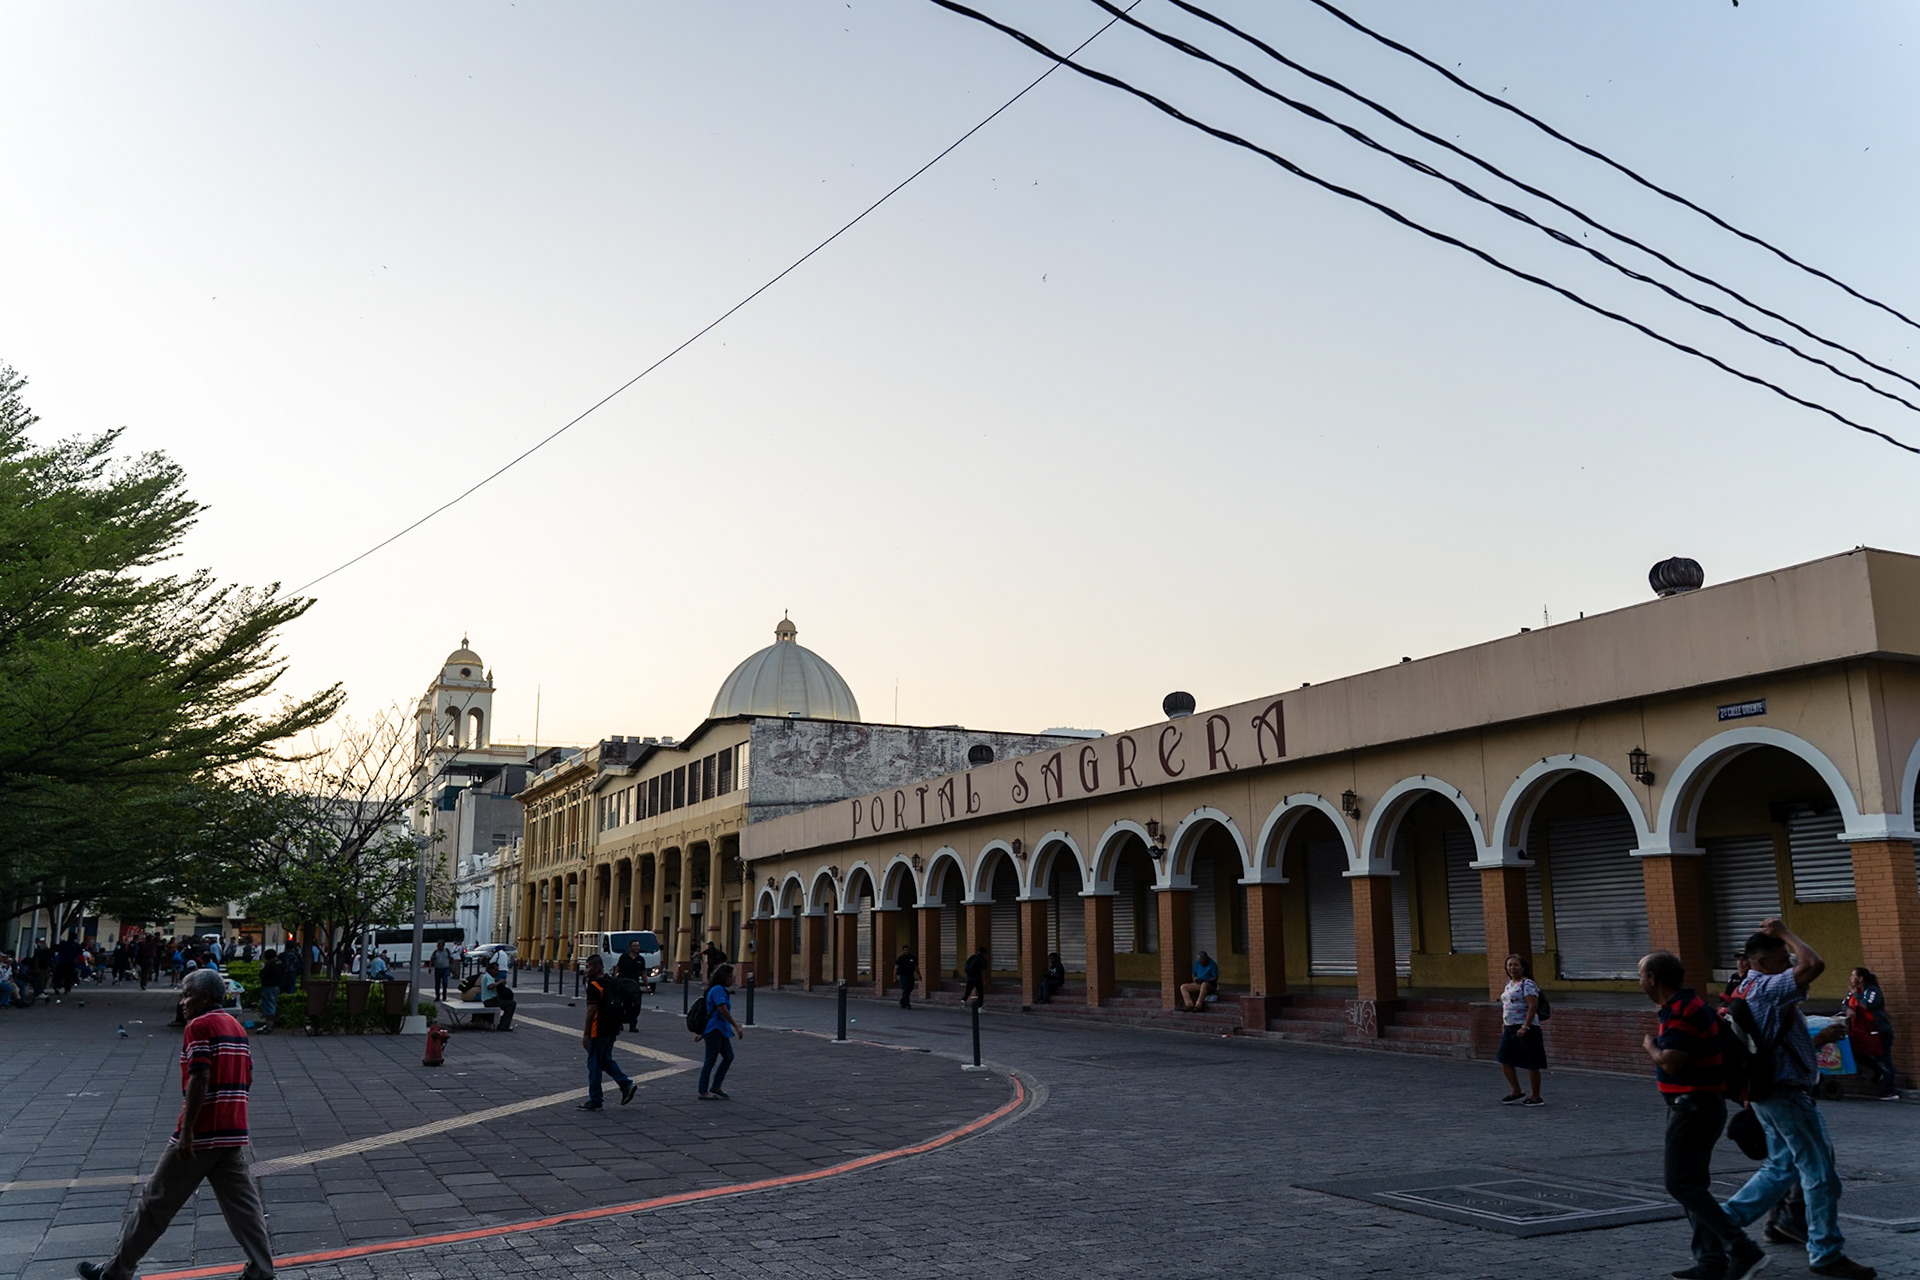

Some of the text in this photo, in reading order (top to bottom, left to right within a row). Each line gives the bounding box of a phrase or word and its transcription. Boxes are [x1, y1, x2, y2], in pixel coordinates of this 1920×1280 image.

[1728, 705, 1742, 717] CALLE
[1742, 702, 1763, 714] ORIENTE
[851, 699, 1288, 839] PORTAL SAGRERA
